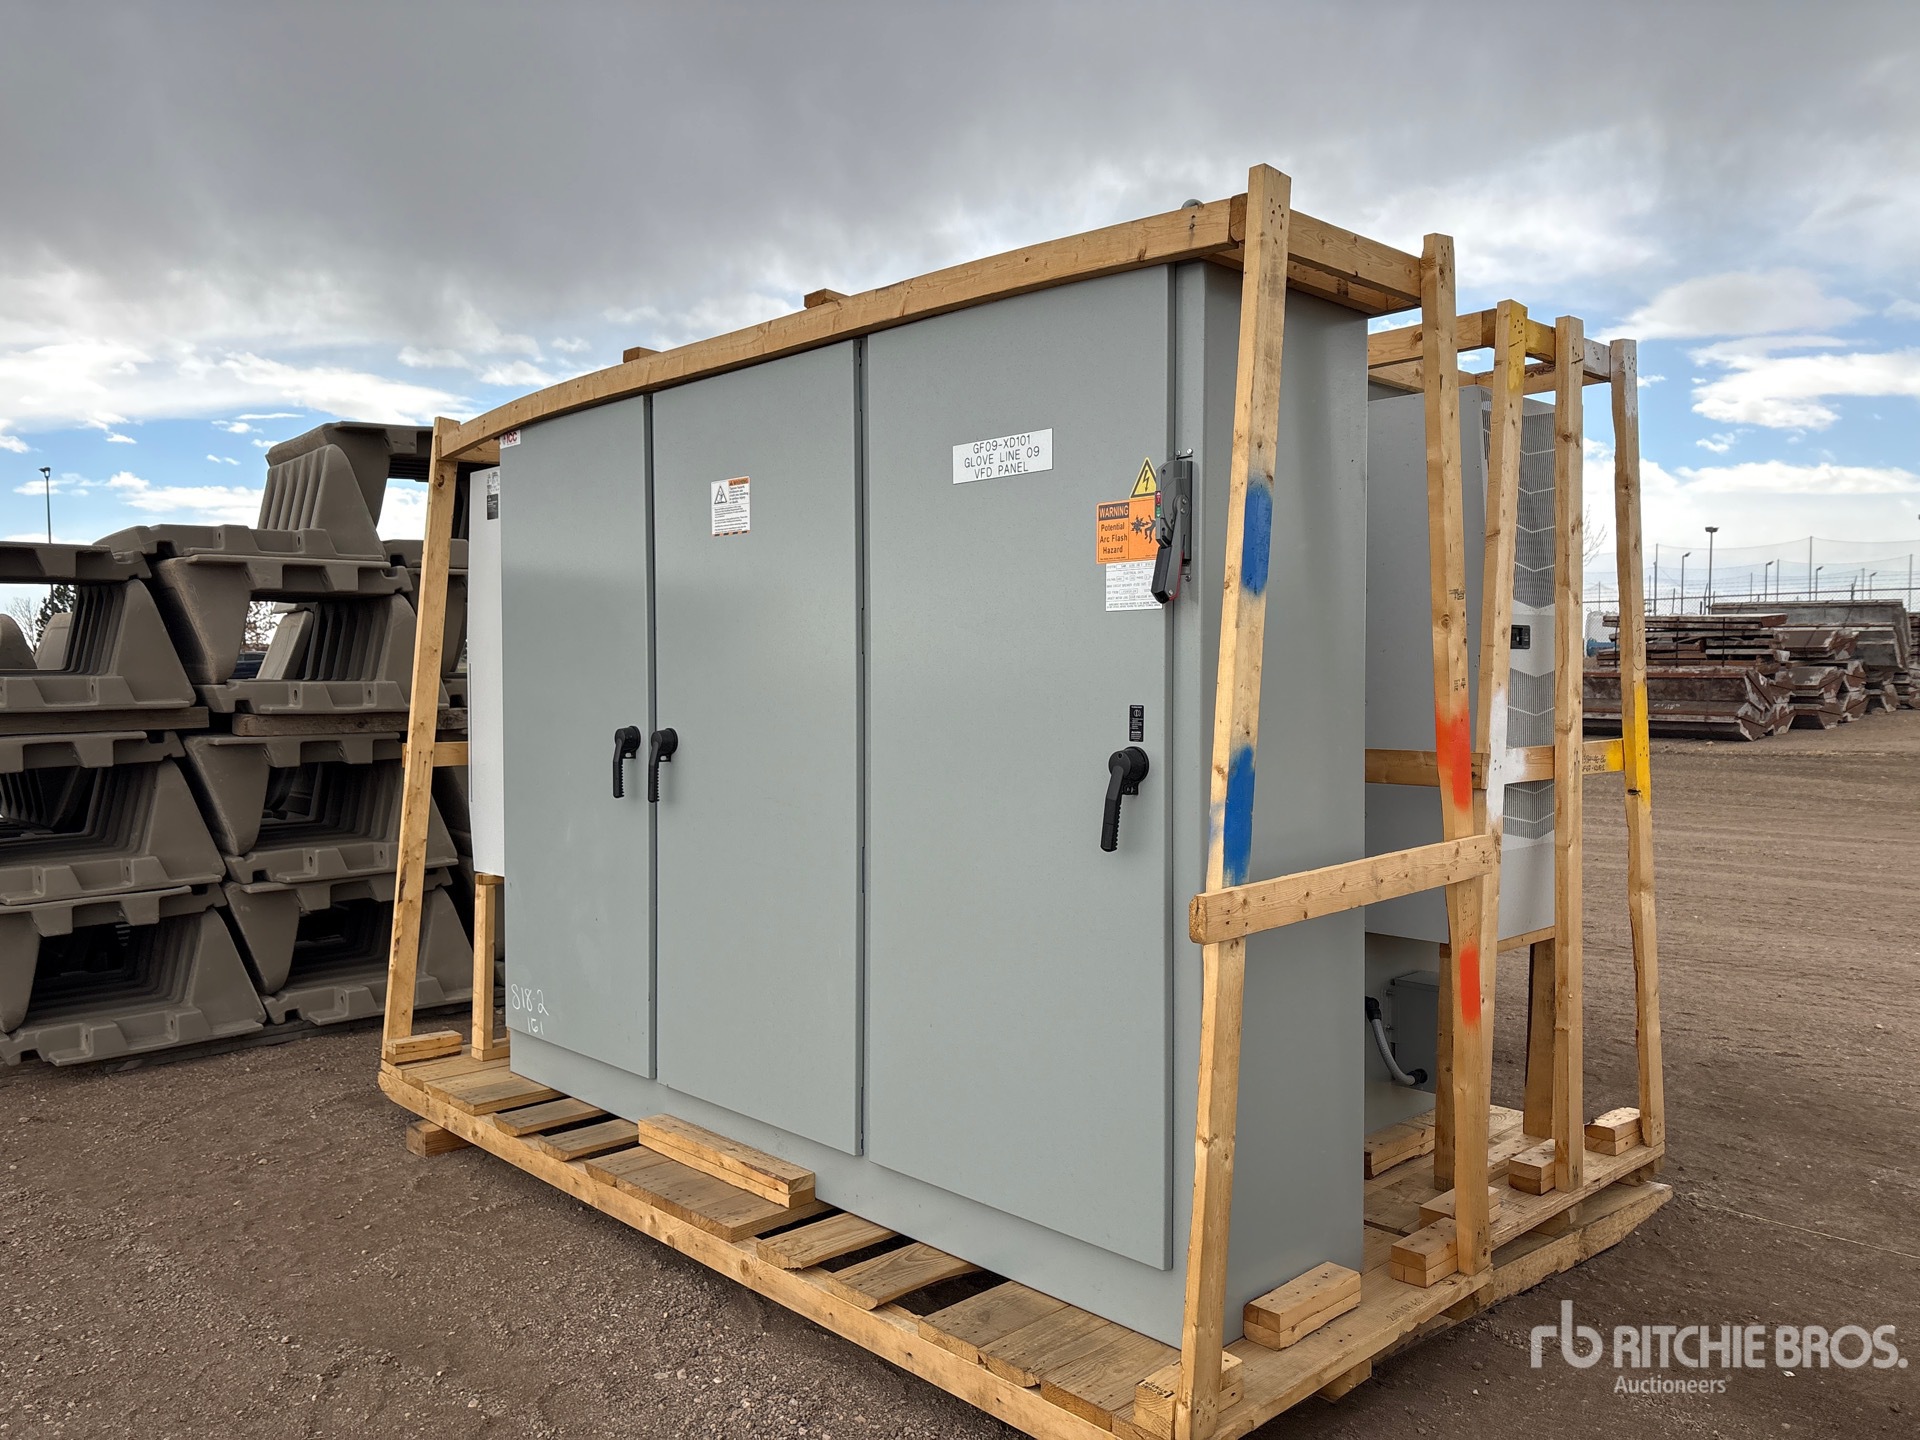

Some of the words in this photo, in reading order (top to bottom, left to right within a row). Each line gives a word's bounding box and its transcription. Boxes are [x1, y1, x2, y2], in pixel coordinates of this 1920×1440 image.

[972, 434, 1031, 454] GF09-XD101
[964, 453, 994, 468] GLOVE
[999, 449, 1021, 463] LINE
[1026, 445, 1040, 458] 09
[974, 466, 993, 479] VFD
[998, 461, 1029, 475] PANEL
[1099, 504, 1129, 519] WARNING
[1100, 522, 1125, 532] Potential
[1100, 535, 1110, 543] Arc
[1111, 533, 1128, 542] Flash
[1102, 544, 1124, 555] Hazard
